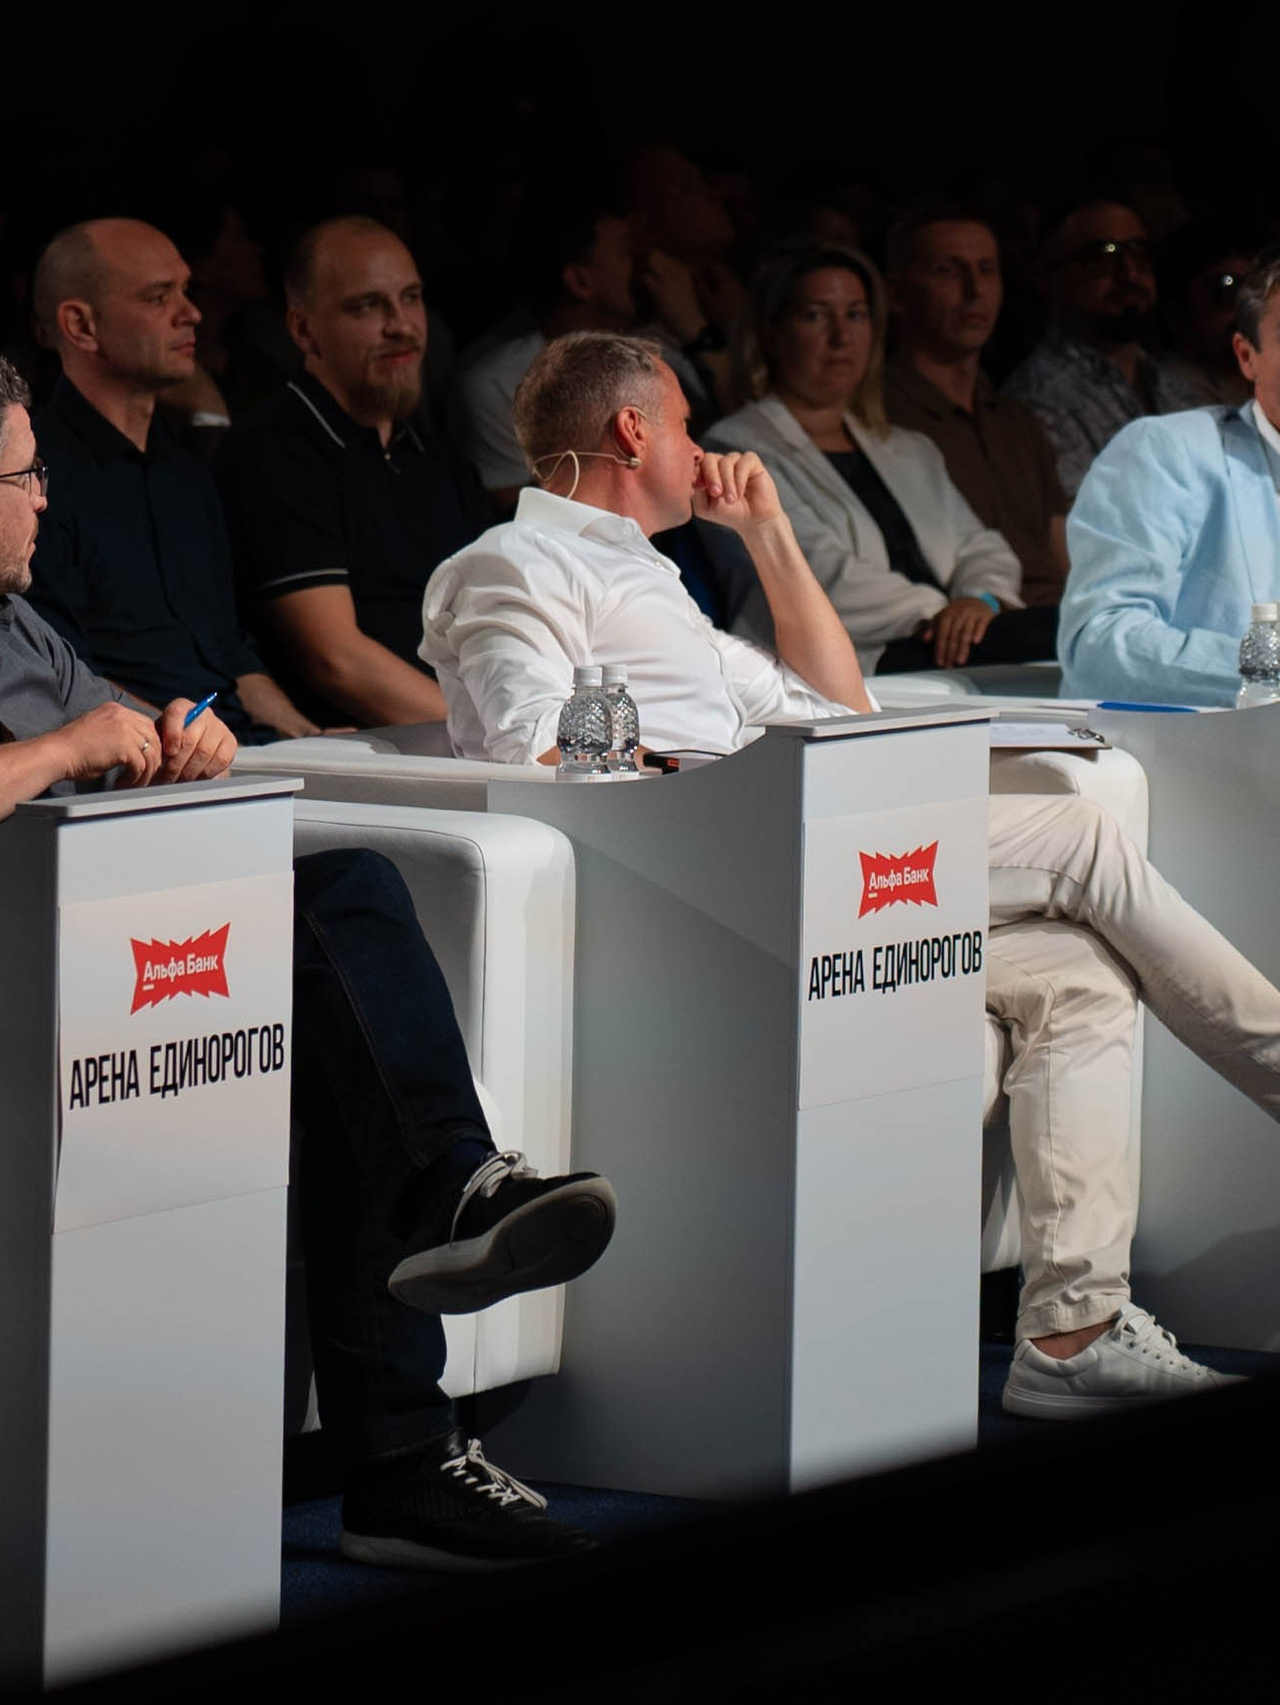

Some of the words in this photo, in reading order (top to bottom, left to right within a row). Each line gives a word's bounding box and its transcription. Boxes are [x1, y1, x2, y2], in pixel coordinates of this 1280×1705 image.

[868, 868, 902, 892] Альфа
[903, 866, 929, 884] Банк
[142, 957, 185, 982] Альфа
[186, 953, 219, 974] Банк
[808, 949, 865, 1001] АРЕНА
[872, 930, 982, 994] ЕДИНОРОГОВ
[69, 1049, 140, 1110] АРЕНА
[149, 1023, 285, 1099] ЕДИНОРОГОВ
